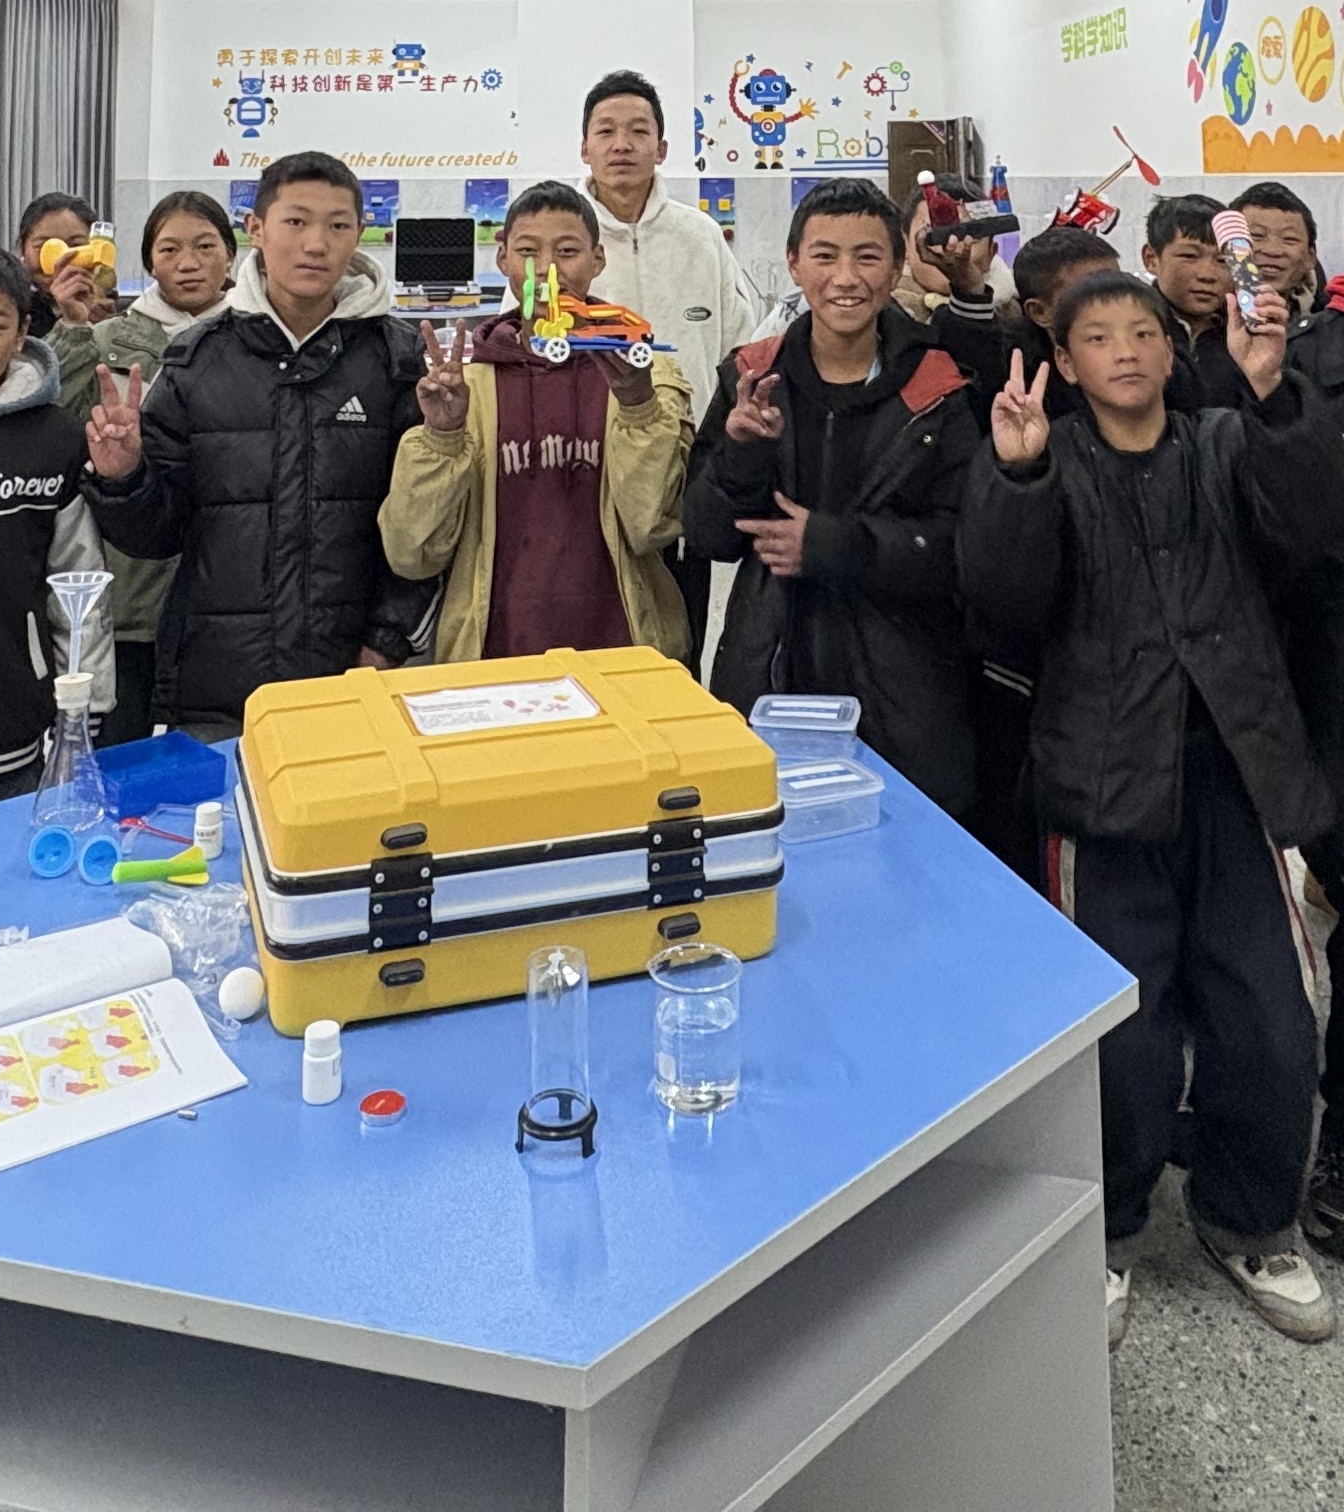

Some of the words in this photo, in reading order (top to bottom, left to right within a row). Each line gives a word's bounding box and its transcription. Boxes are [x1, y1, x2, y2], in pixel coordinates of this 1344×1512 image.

[1060, 6, 1129, 64] 学科学知识
[216, 48, 385, 68] 勇于探索开创未来
[269, 73, 479, 94] 科技创新是第一生产力
[816, 128, 888, 158] Rob
[239, 151, 271, 168] The
[348, 151, 377, 167] the
[379, 151, 435, 167] future
[437, 150, 507, 167] created
[506, 150, 519, 166] b
